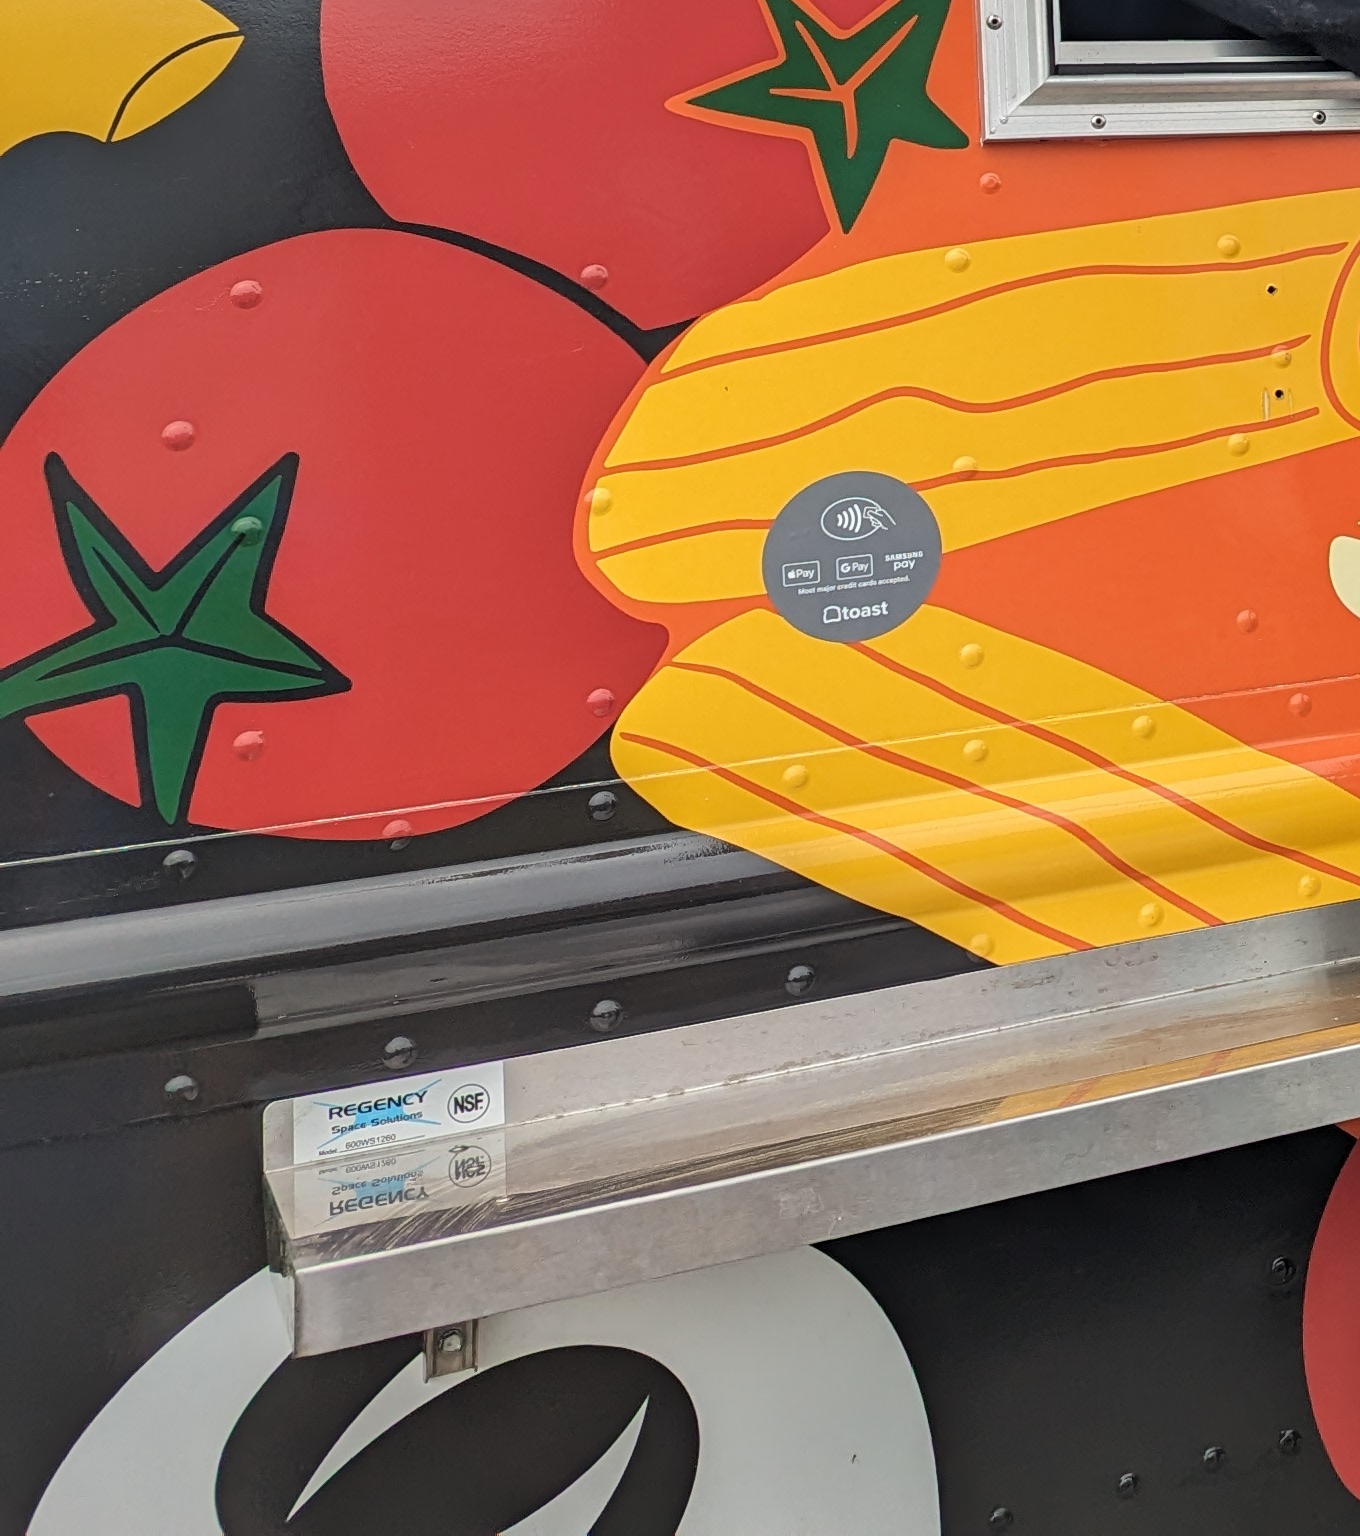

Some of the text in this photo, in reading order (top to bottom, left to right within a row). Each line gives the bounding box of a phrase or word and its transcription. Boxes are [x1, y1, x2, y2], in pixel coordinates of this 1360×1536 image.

[852, 562, 869, 573] Pay
[893, 559, 916, 571] pay
[796, 568, 815, 579] Pay
[841, 601, 889, 620] toast
[328, 1090, 428, 1121] REGENCY
[331, 1111, 424, 1135] Space Solutions
